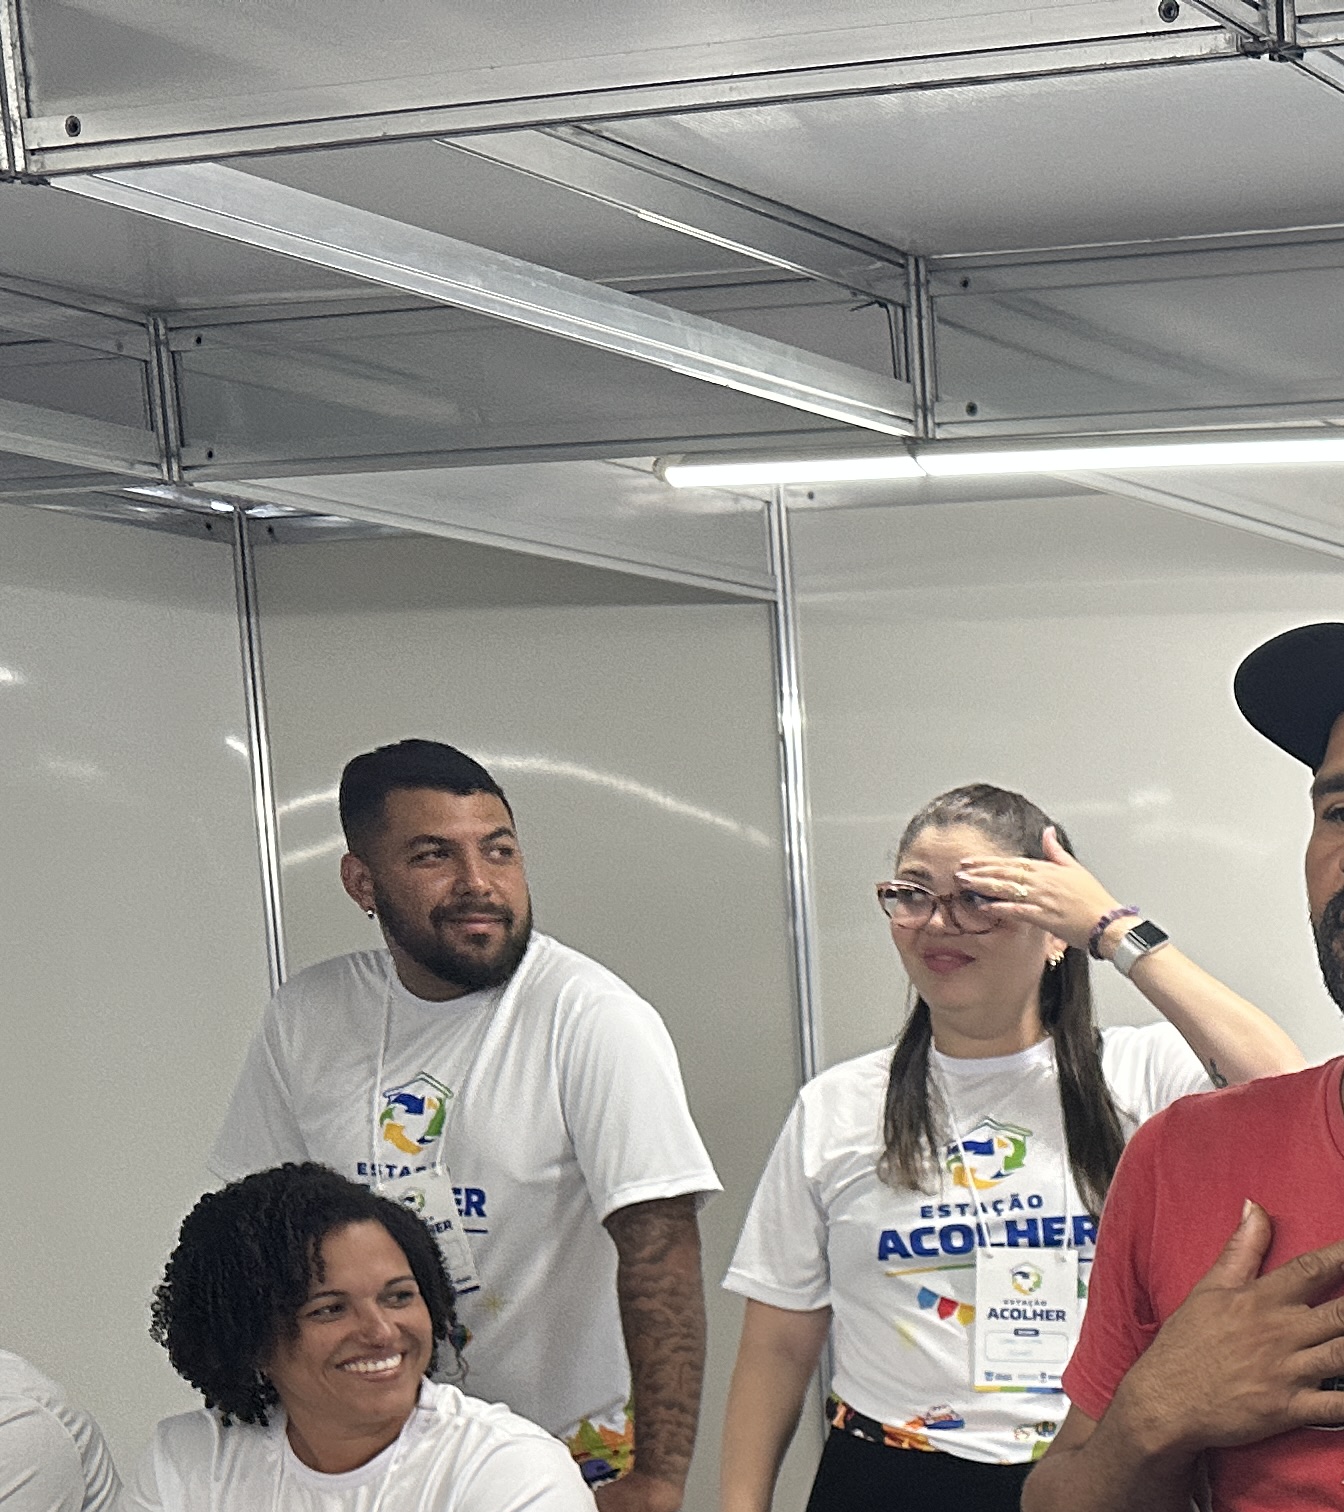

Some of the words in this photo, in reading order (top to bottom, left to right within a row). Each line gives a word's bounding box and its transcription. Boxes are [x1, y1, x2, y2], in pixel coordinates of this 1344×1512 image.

[920, 1193, 1044, 1219] ESTAÇÃO
[877, 1214, 1102, 1262] ACOLHER
[987, 1307, 1067, 1322] ACOLHER
